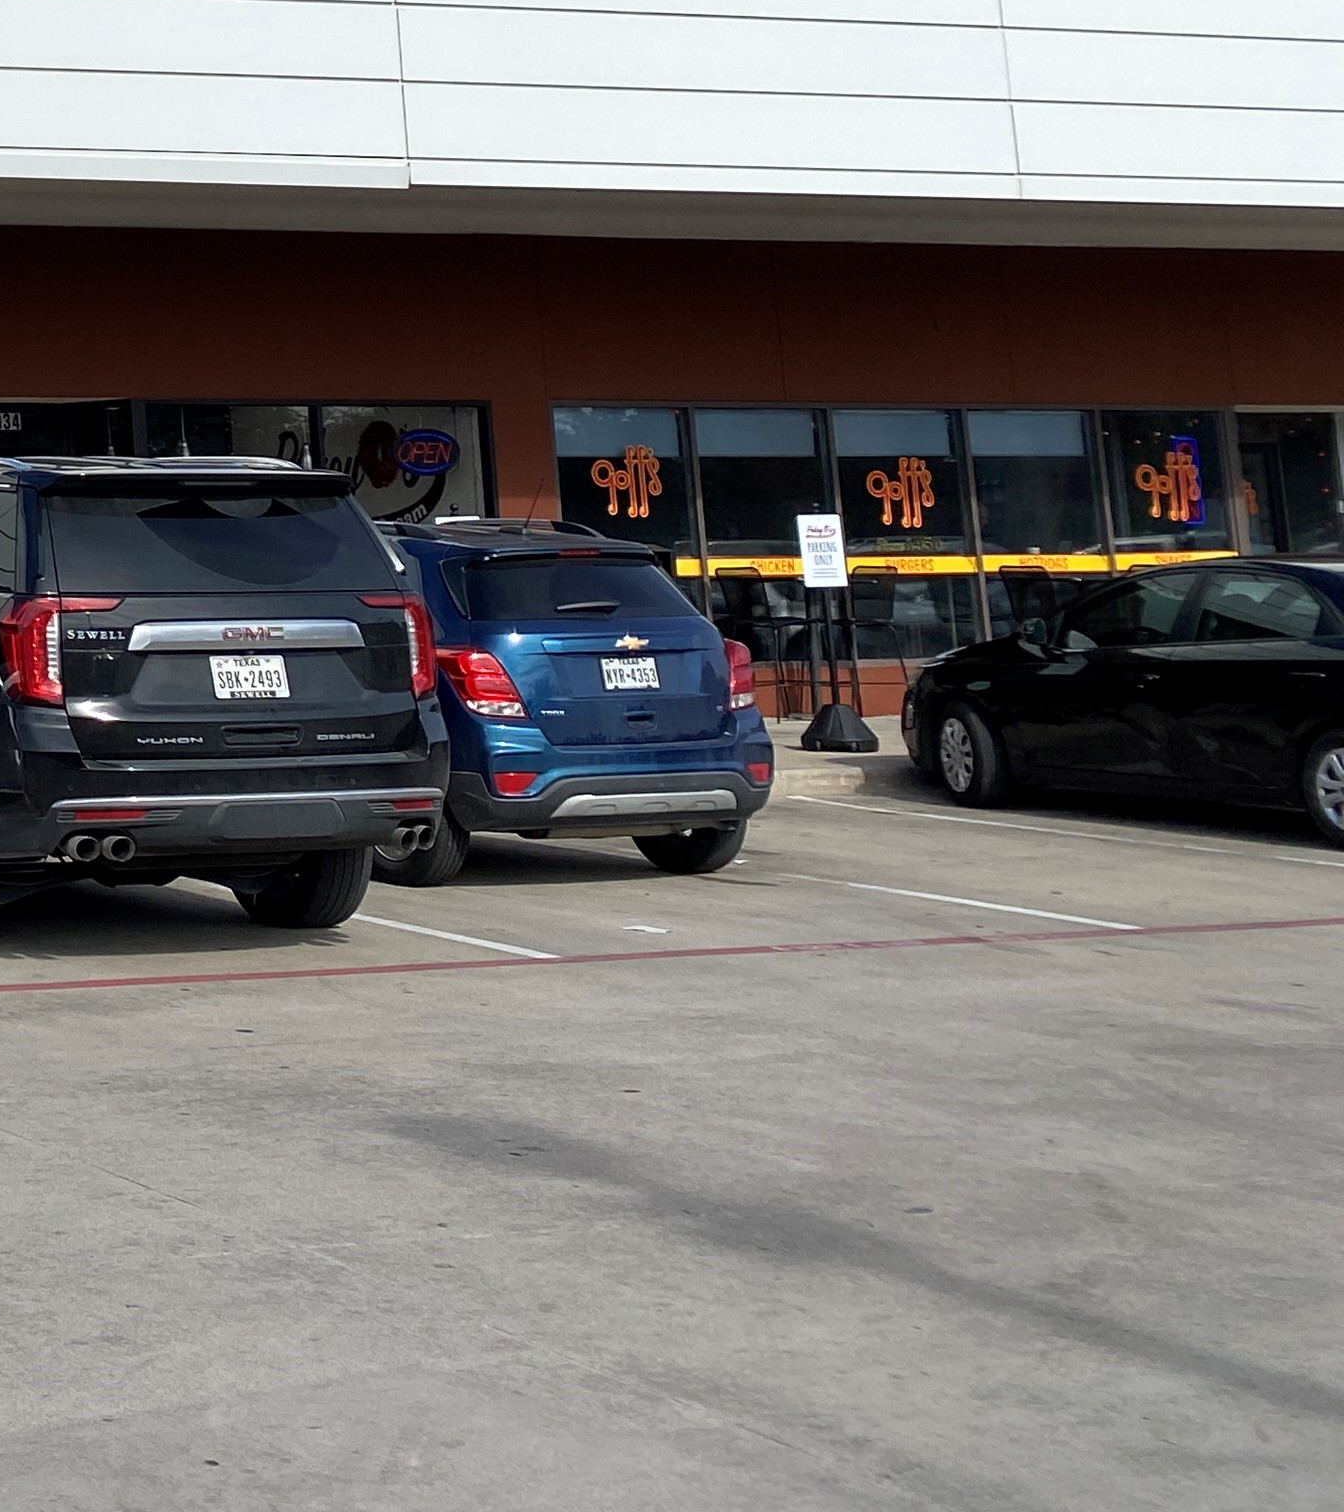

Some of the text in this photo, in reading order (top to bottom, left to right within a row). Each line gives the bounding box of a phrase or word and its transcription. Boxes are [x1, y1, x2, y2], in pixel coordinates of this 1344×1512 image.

[398, 441, 453, 464] OPEN
[807, 542, 838, 553] PARKING
[750, 559, 795, 573] CHICKEN
[814, 555, 833, 566] ONLY
[885, 558, 934, 571] BURGERS
[67, 629, 125, 640] SEWELL
[220, 626, 284, 642] GMC
[233, 658, 260, 666] TEXAS
[136, 736, 203, 744] YUKON
[317, 733, 375, 741] DENALI
